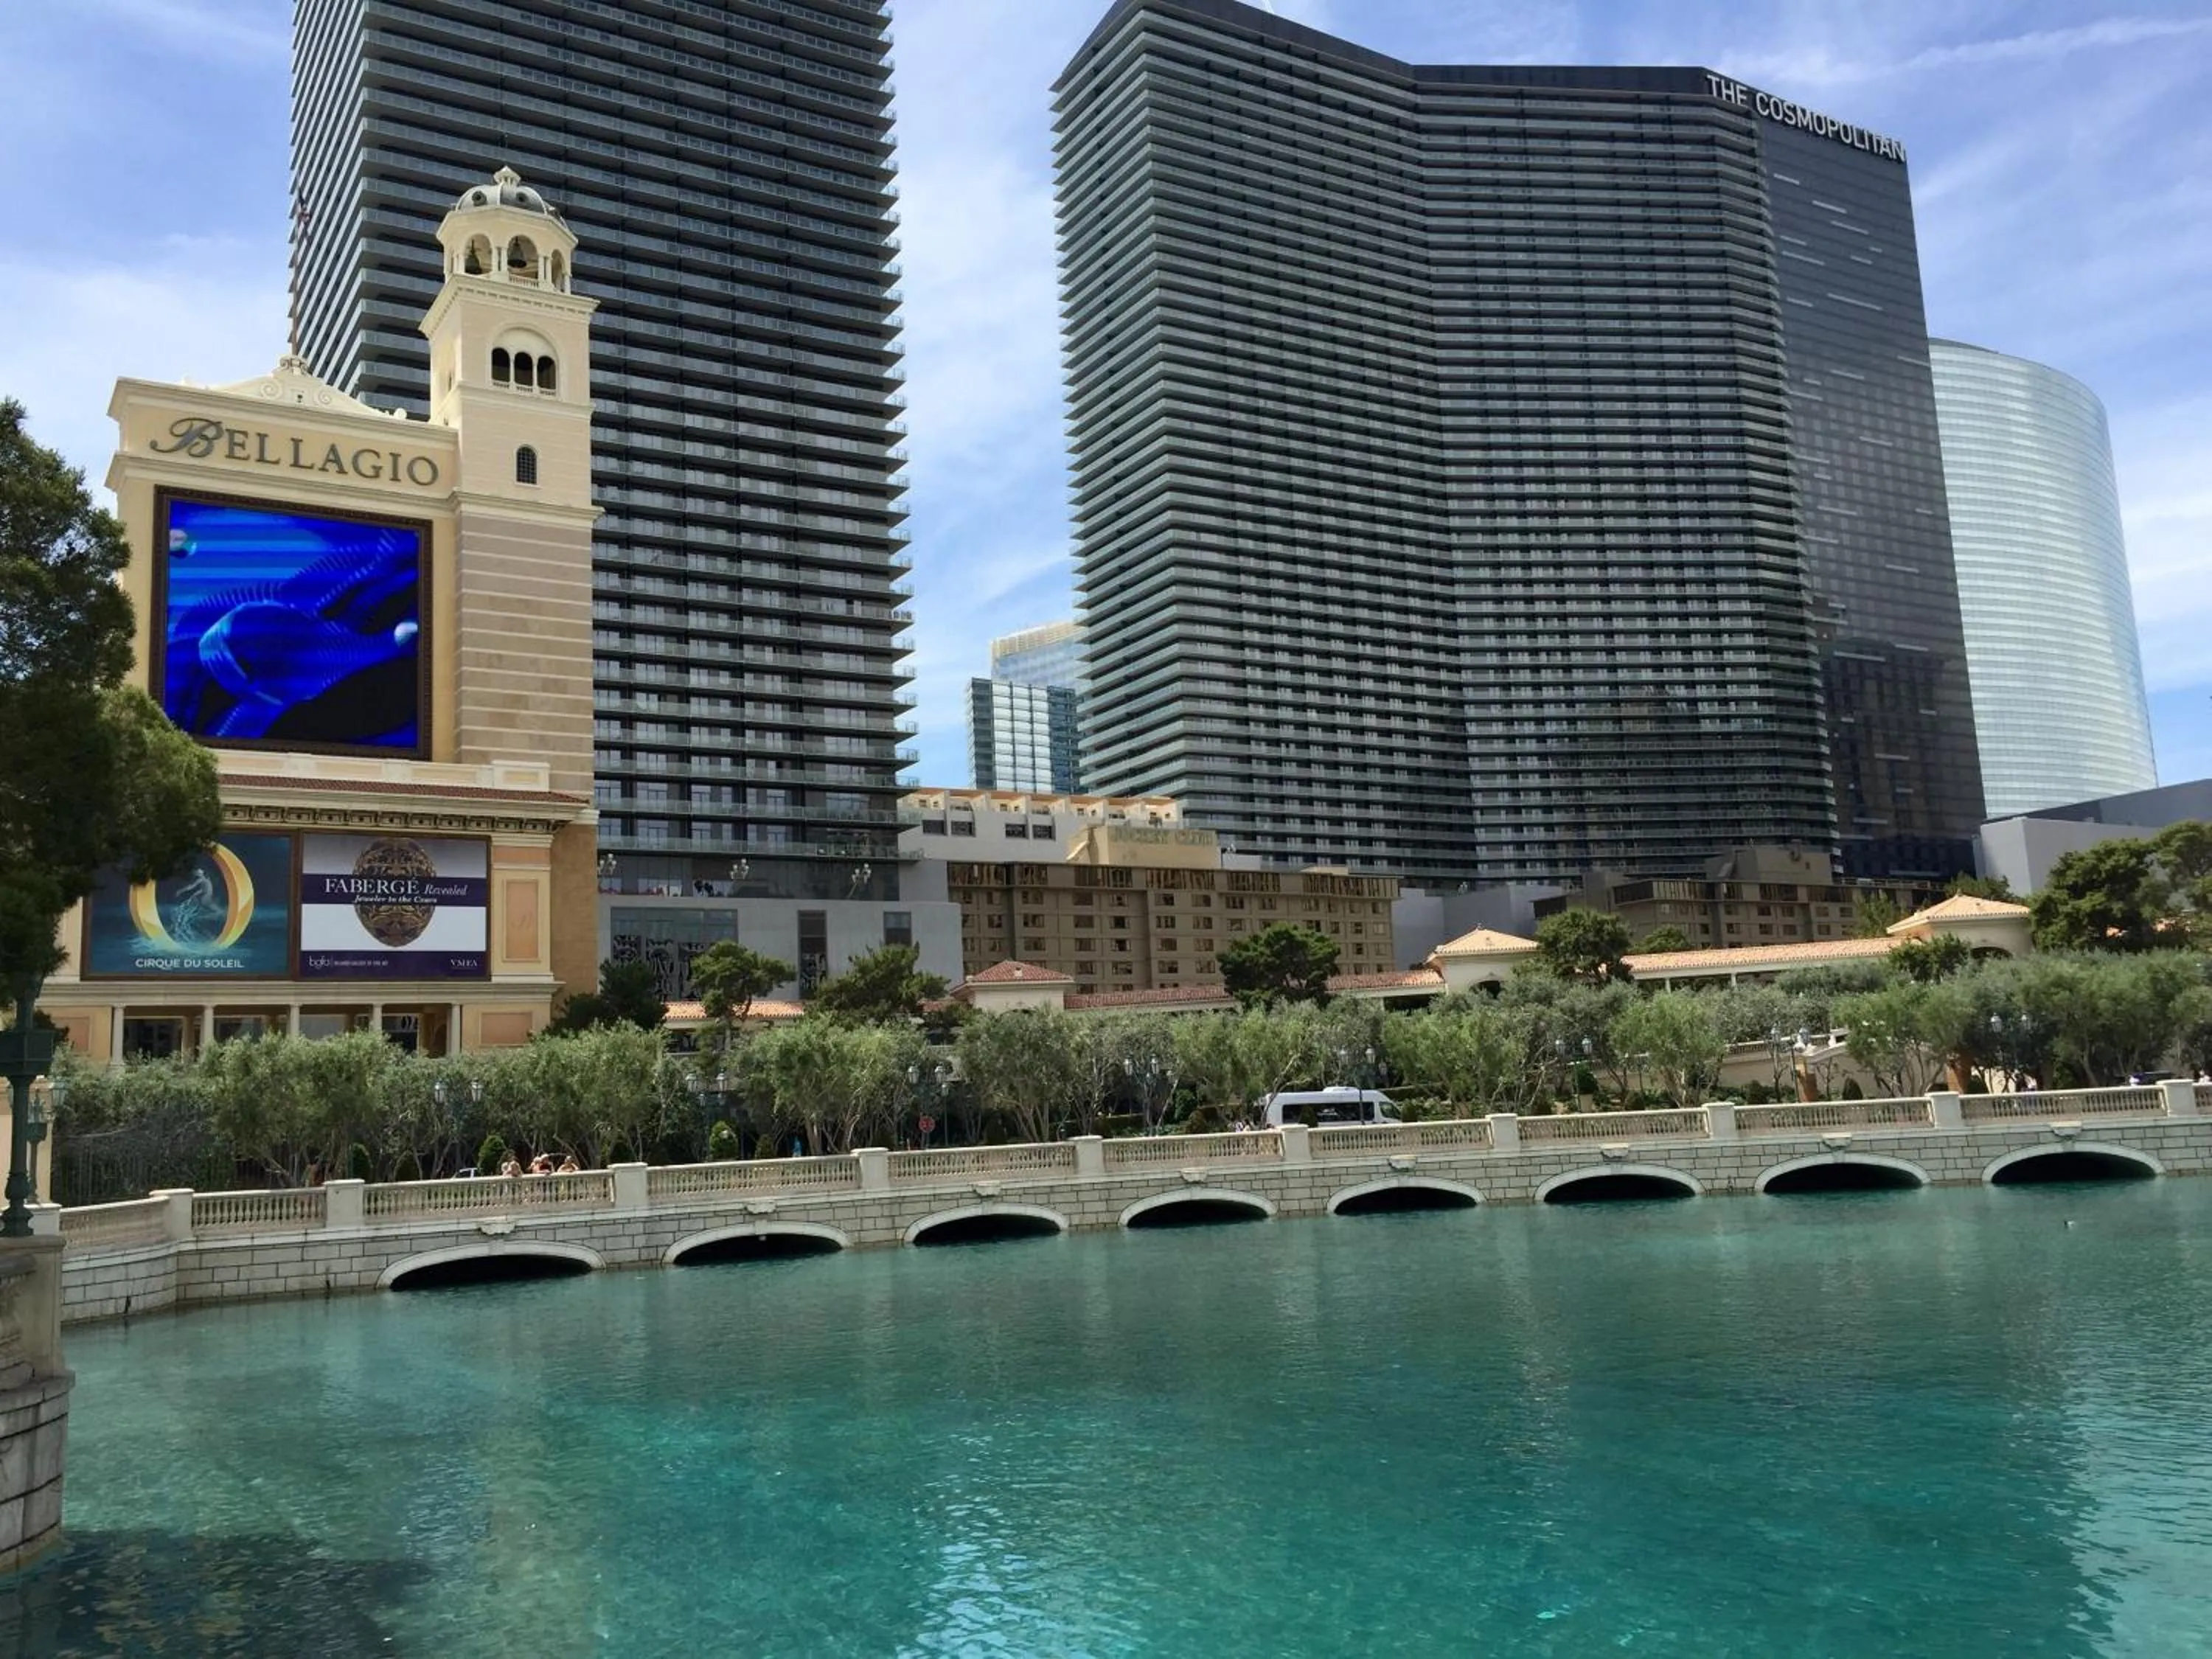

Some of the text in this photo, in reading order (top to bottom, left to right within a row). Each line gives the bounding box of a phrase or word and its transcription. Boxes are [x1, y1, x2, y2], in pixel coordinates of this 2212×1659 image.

[1707, 75, 1906, 162] THE COSMOPOLITAN
[150, 417, 439, 486] BELLAGIO
[324, 877, 420, 894] FABERGÉ
[135, 959, 244, 970] CIRQUE DU SOLEIL
